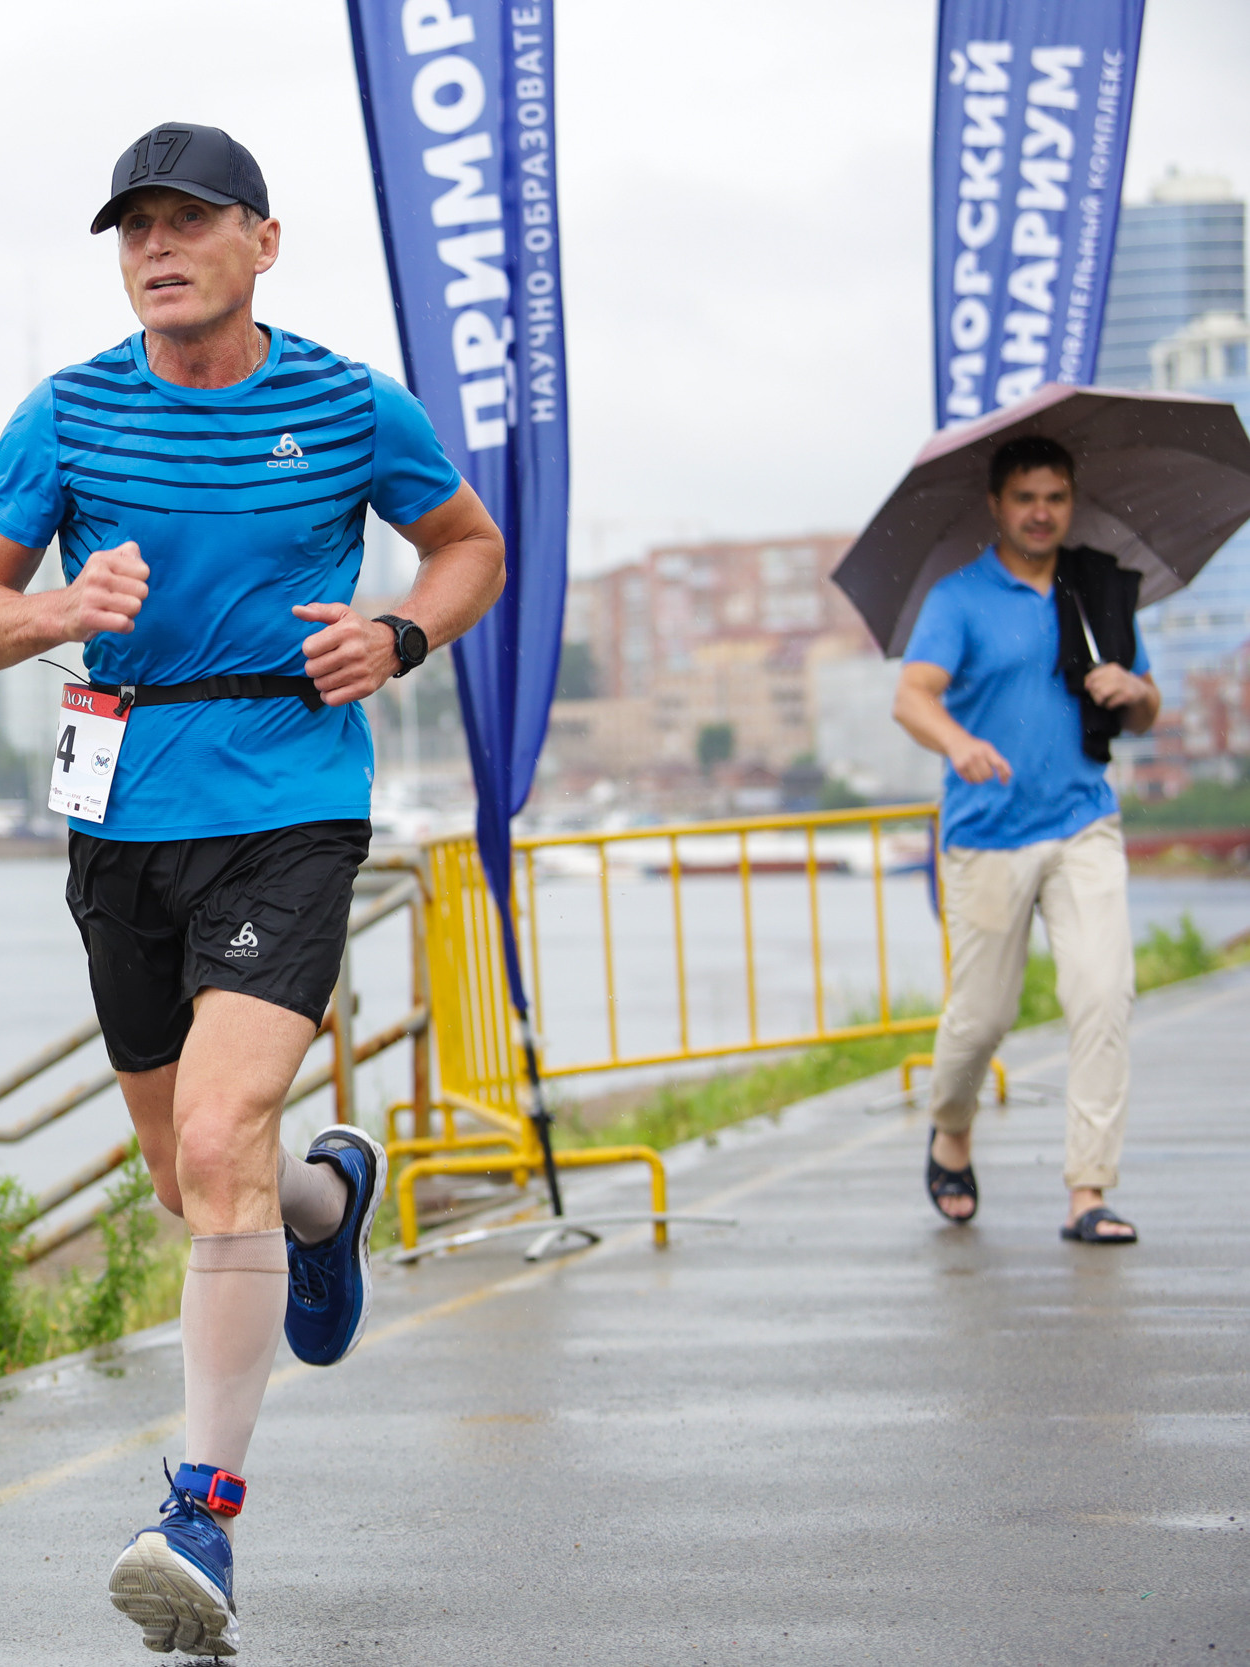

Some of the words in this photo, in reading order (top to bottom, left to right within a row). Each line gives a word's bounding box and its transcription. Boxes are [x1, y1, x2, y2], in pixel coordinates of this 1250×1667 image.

[129, 130, 192, 185] 17
[401, 0, 510, 451] ПРИМОР
[512, 0, 558, 422] НАУЧНО-ОБРАЗОВАТЕ
[266, 459, 309, 469] odlo
[56, 724, 77, 773] 4
[224, 948, 258, 957] odlo
